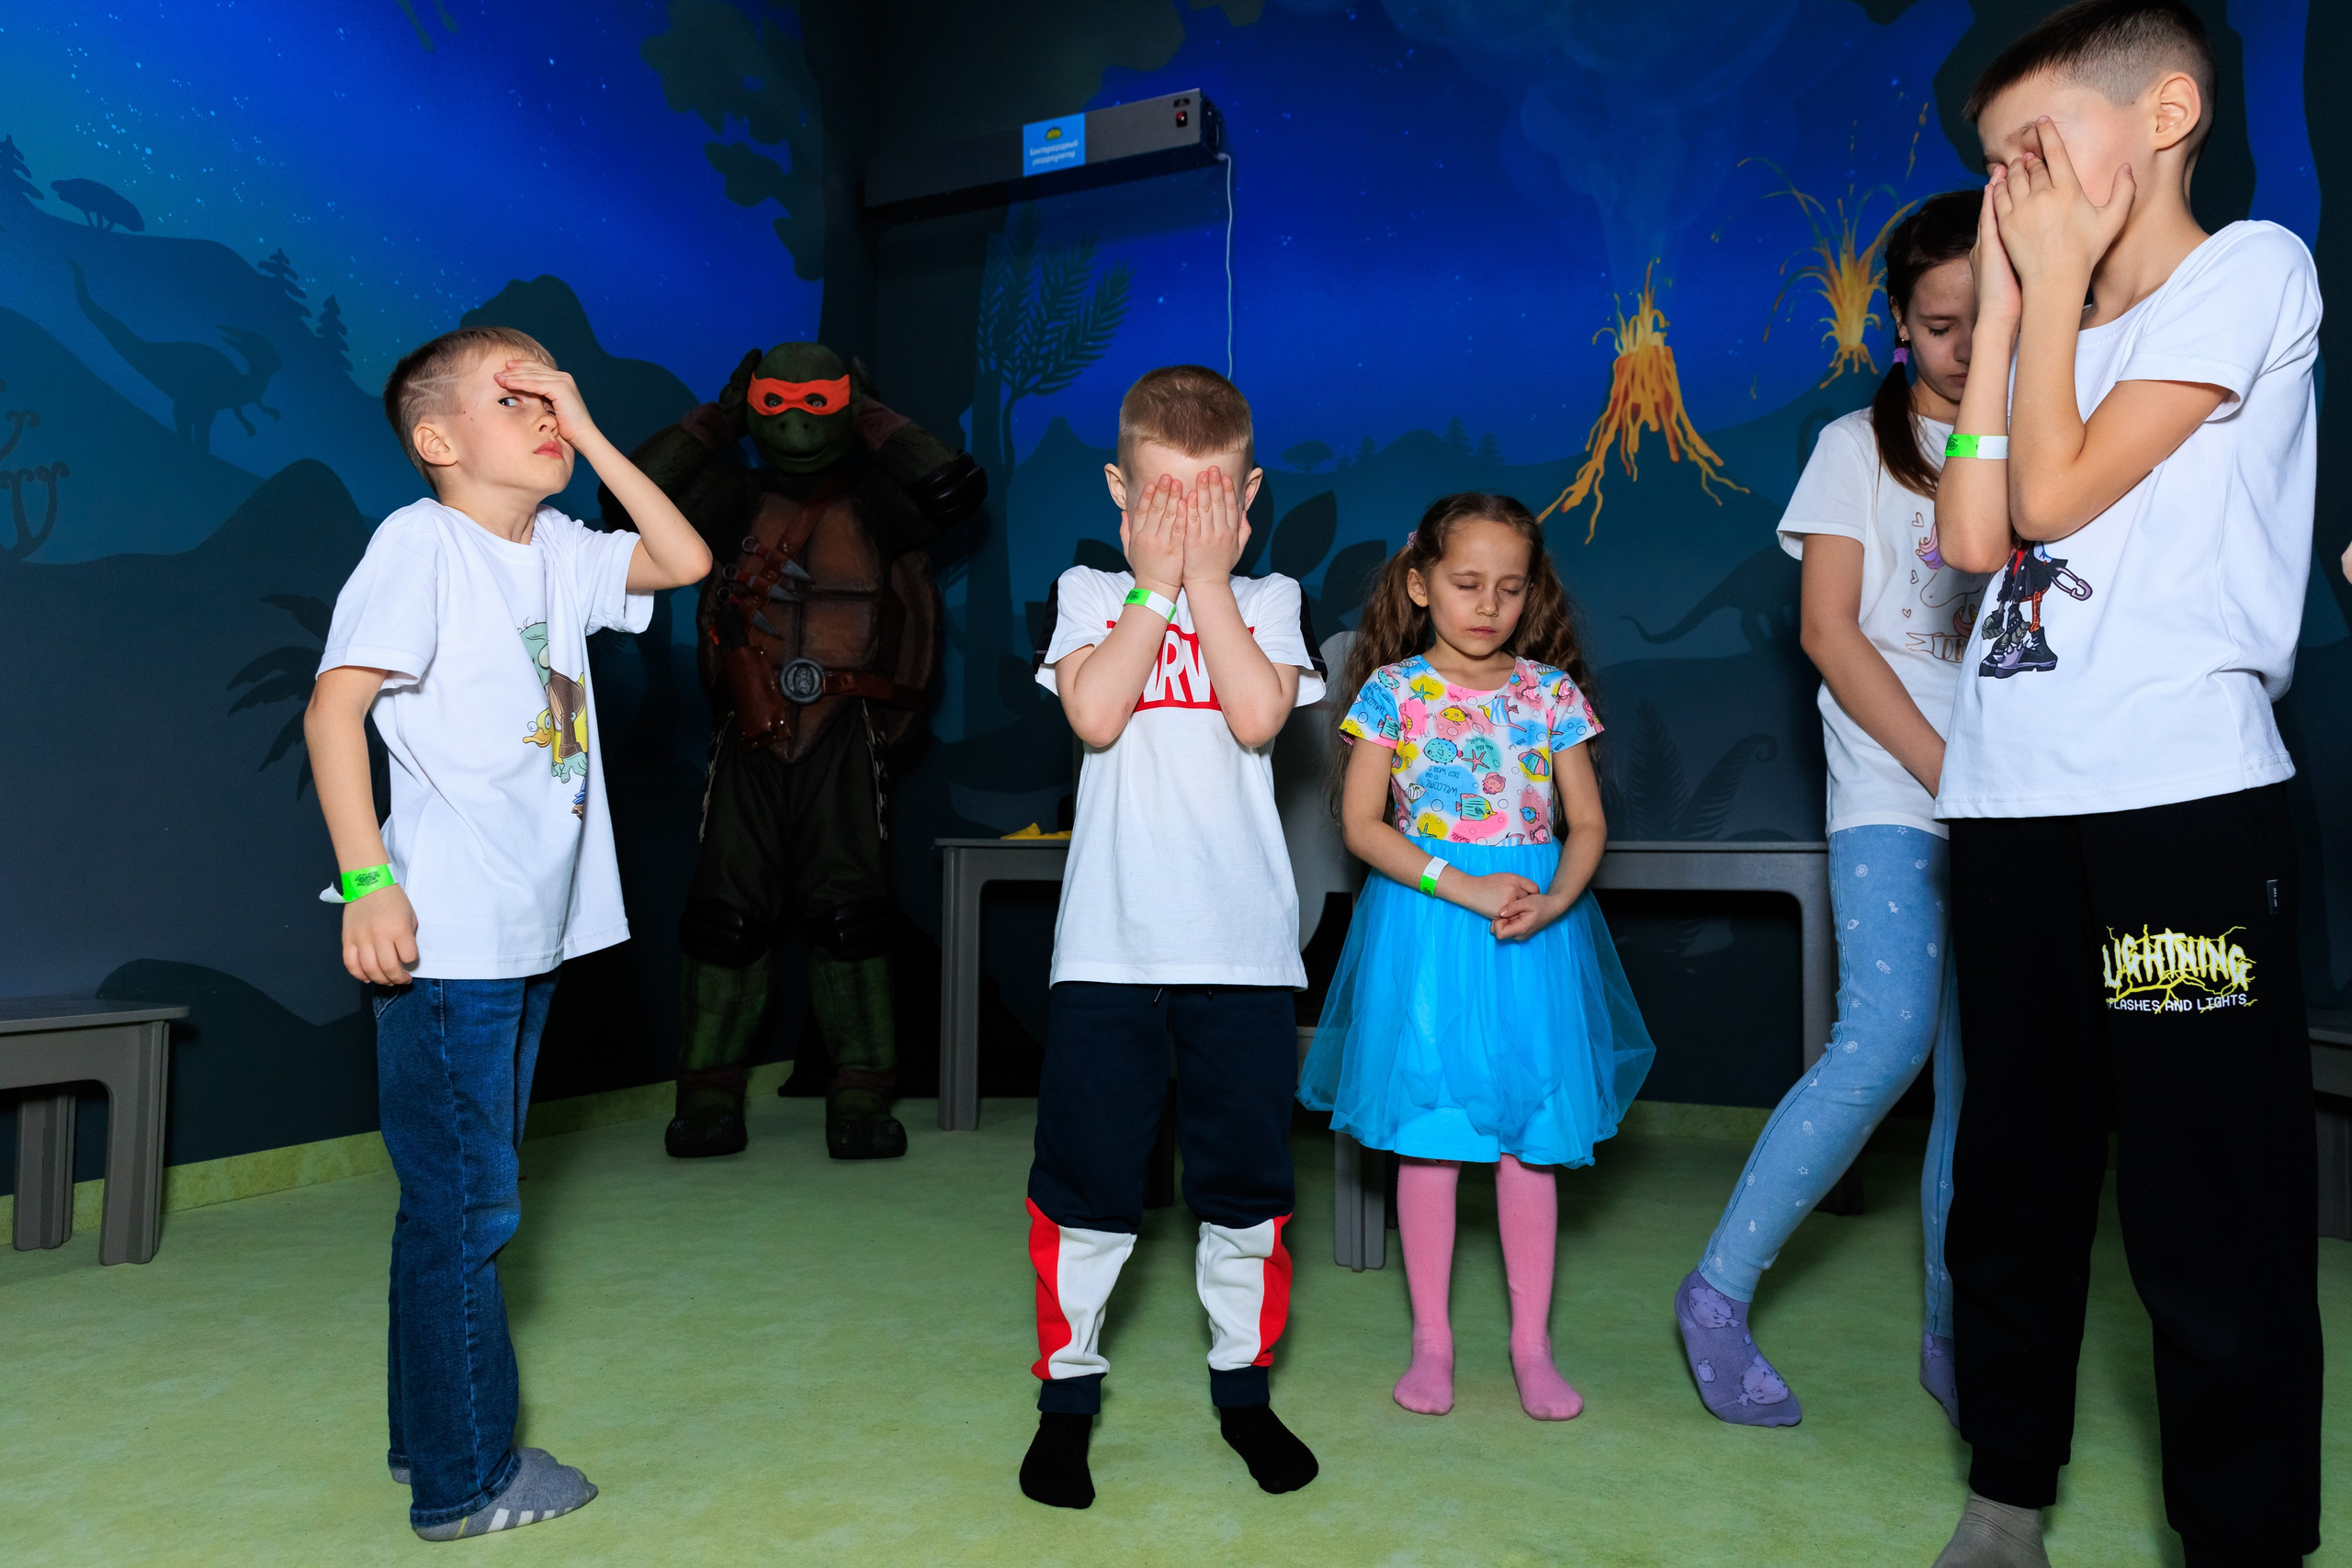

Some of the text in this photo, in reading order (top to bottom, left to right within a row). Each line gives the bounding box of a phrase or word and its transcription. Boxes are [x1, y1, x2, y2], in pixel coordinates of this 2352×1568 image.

[1941, 637, 1967, 660] DR
[1428, 764, 1447, 775] WORLD
[1426, 779, 1457, 795] WELCOME
[2102, 928, 2252, 991] LIGHTNING
[2165, 999, 2192, 1011] AND
[2197, 993, 2247, 1011] LIGHTS
